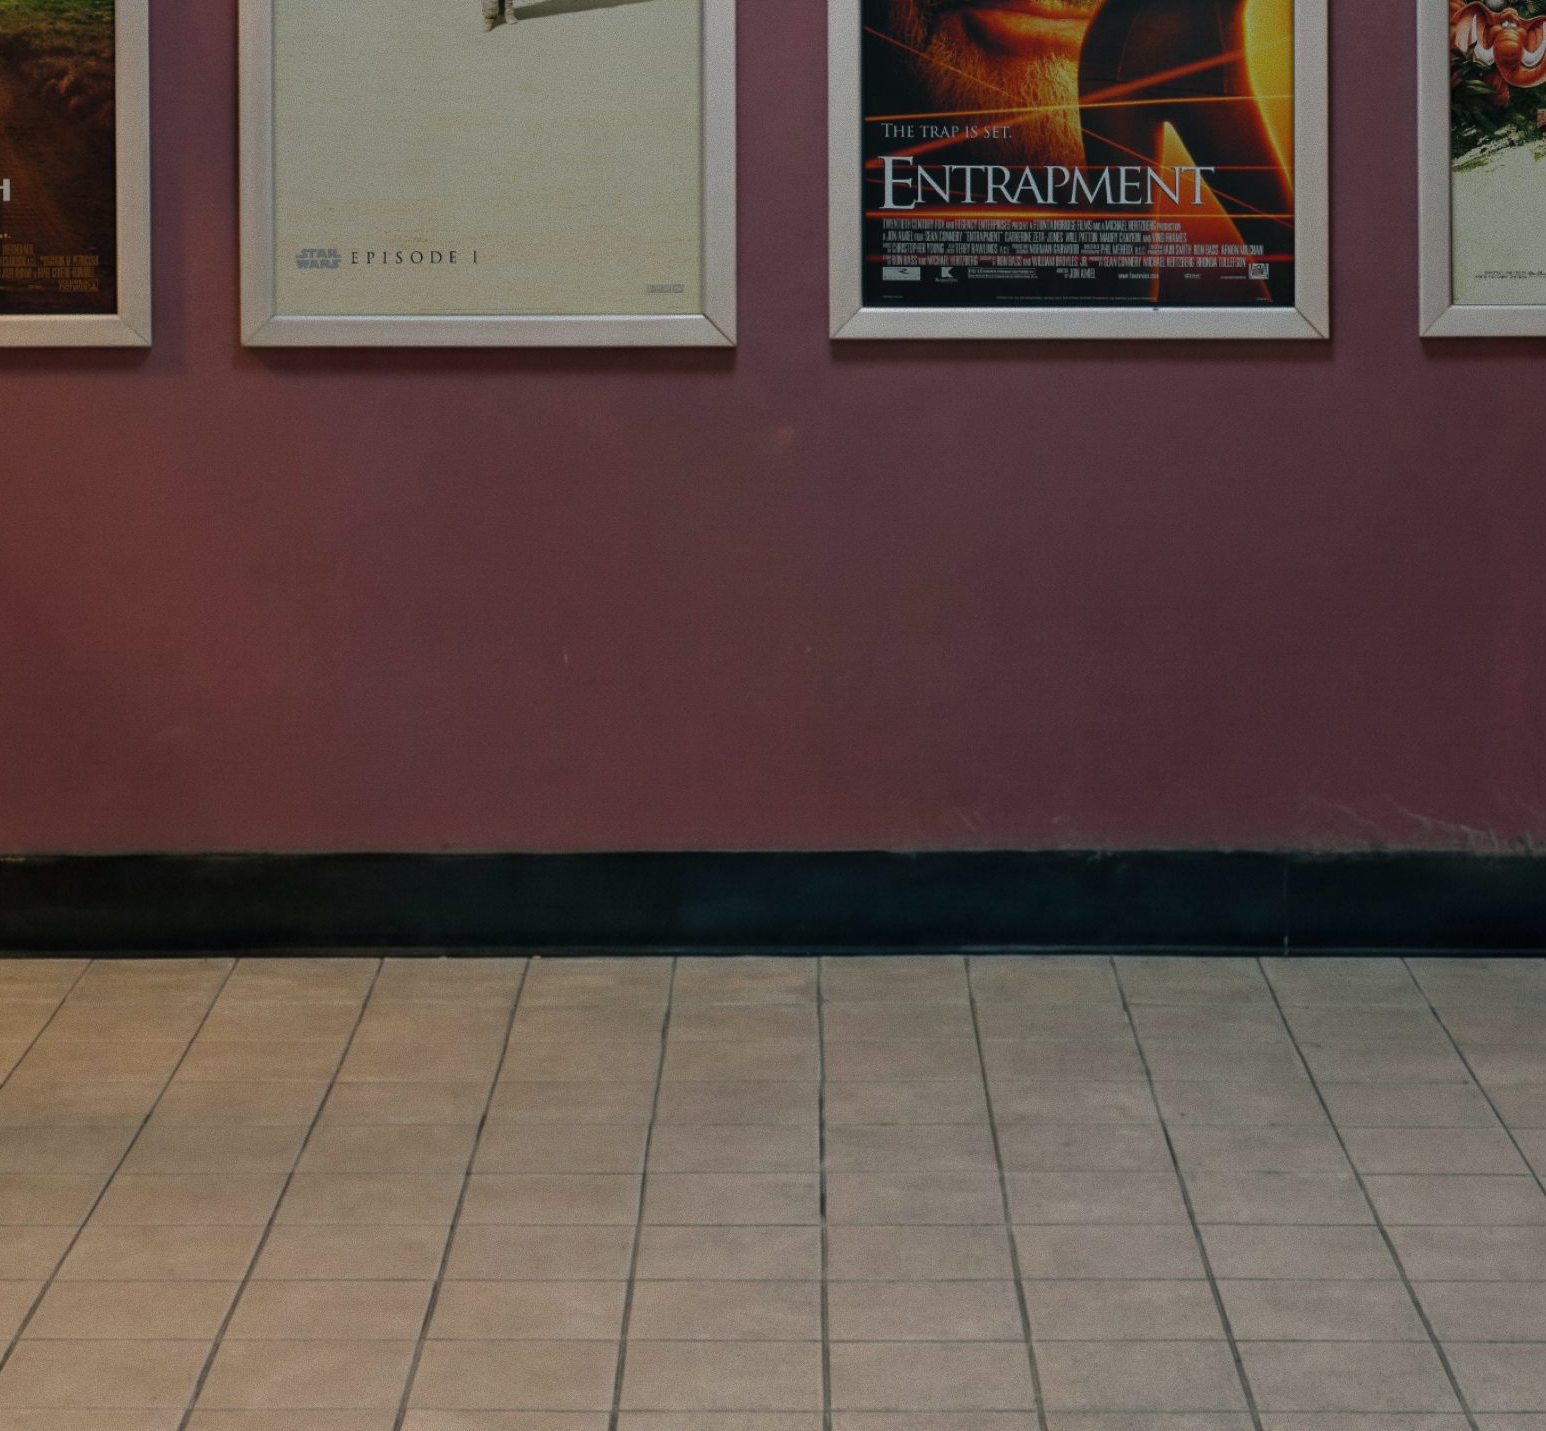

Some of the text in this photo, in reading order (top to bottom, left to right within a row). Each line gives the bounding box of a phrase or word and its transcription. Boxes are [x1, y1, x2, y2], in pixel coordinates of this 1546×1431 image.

[882, 123, 1012, 139] THE TRAP IS SET.
[878, 156, 1215, 210] ENTRAPMENT
[925, 231, 938, 241] SEAN
[939, 231, 962, 241] CONNERY
[1005, 231, 1032, 242] CATHERINE
[1065, 231, 1078, 242] WILL
[295, 249, 341, 259] STAR
[351, 251, 457, 265] EPISODE
[296, 259, 341, 269] WARS
[1117, 256, 1141, 267] CONNERY
